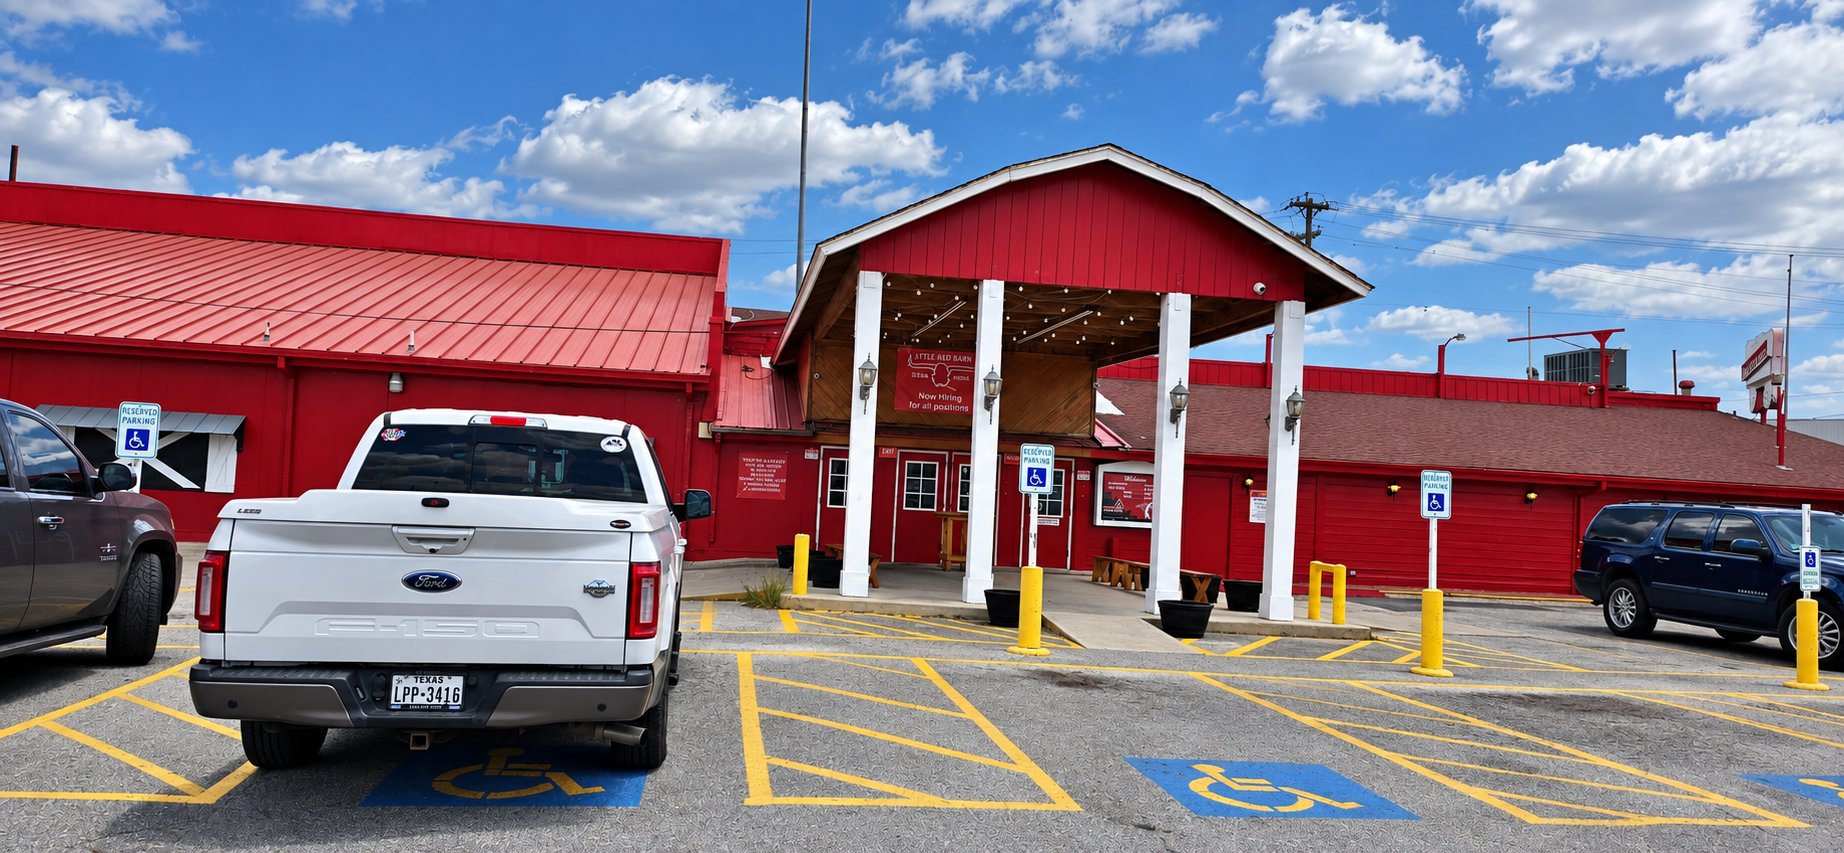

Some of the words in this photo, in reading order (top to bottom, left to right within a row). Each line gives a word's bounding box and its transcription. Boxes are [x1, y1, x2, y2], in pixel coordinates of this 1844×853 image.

[918, 392, 937, 400] Now
[938, 393, 962, 403] Hiring
[122, 406, 158, 416] RESERVED
[909, 401, 920, 409] for
[933, 403, 969, 412] positions
[121, 416, 156, 426] PARKING
[414, 574, 447, 588] Ford
[314, 617, 540, 639] F-150
[414, 676, 444, 684] TEXAS
